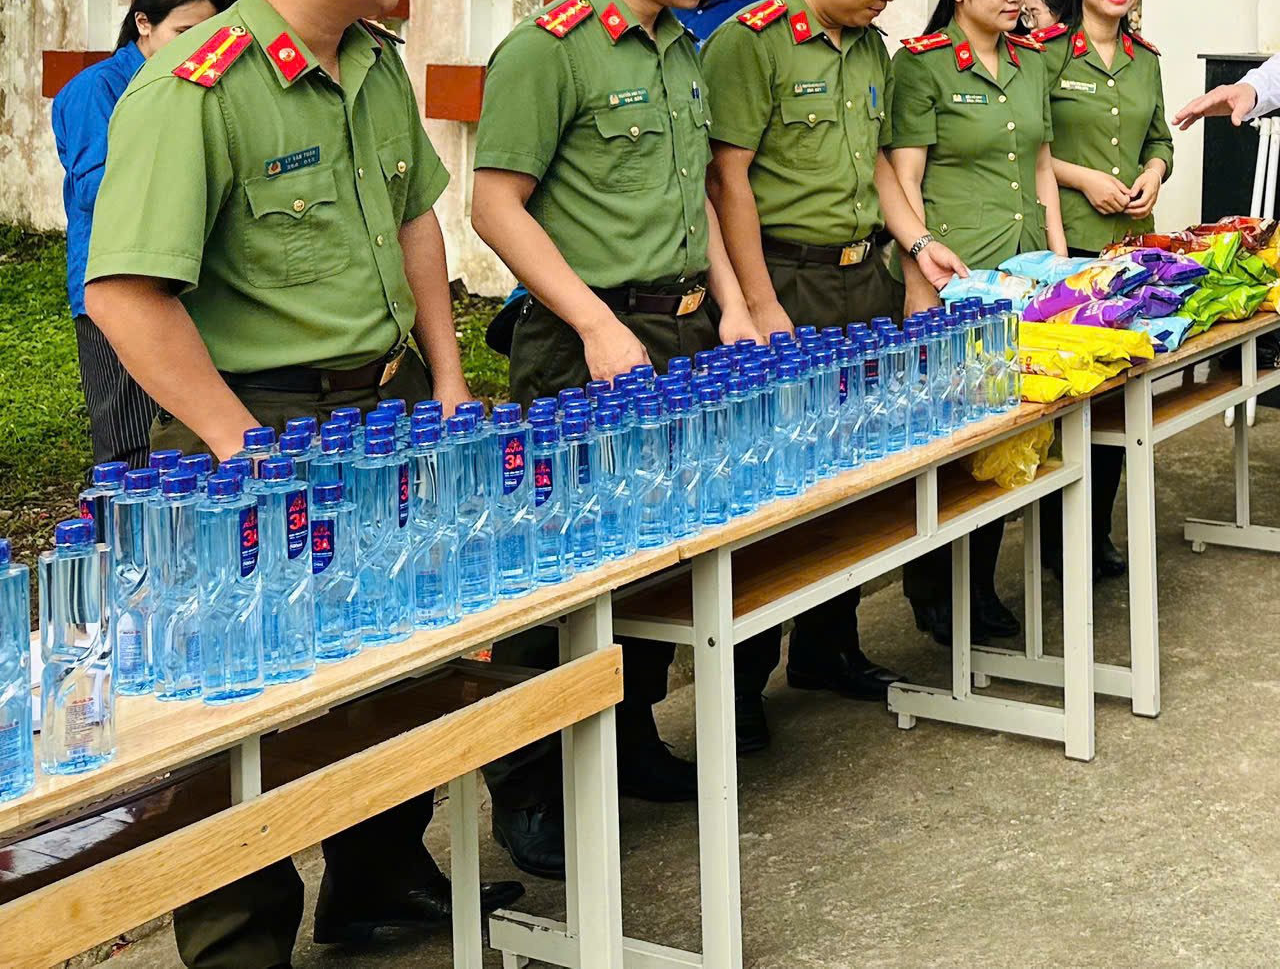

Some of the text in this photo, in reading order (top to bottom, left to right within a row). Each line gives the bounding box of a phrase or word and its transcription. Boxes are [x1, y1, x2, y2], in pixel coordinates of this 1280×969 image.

[504, 454, 524, 470] 3A
[535, 474, 551, 487] 3A
[289, 512, 308, 530] 3A
[312, 537, 331, 552] 3A
